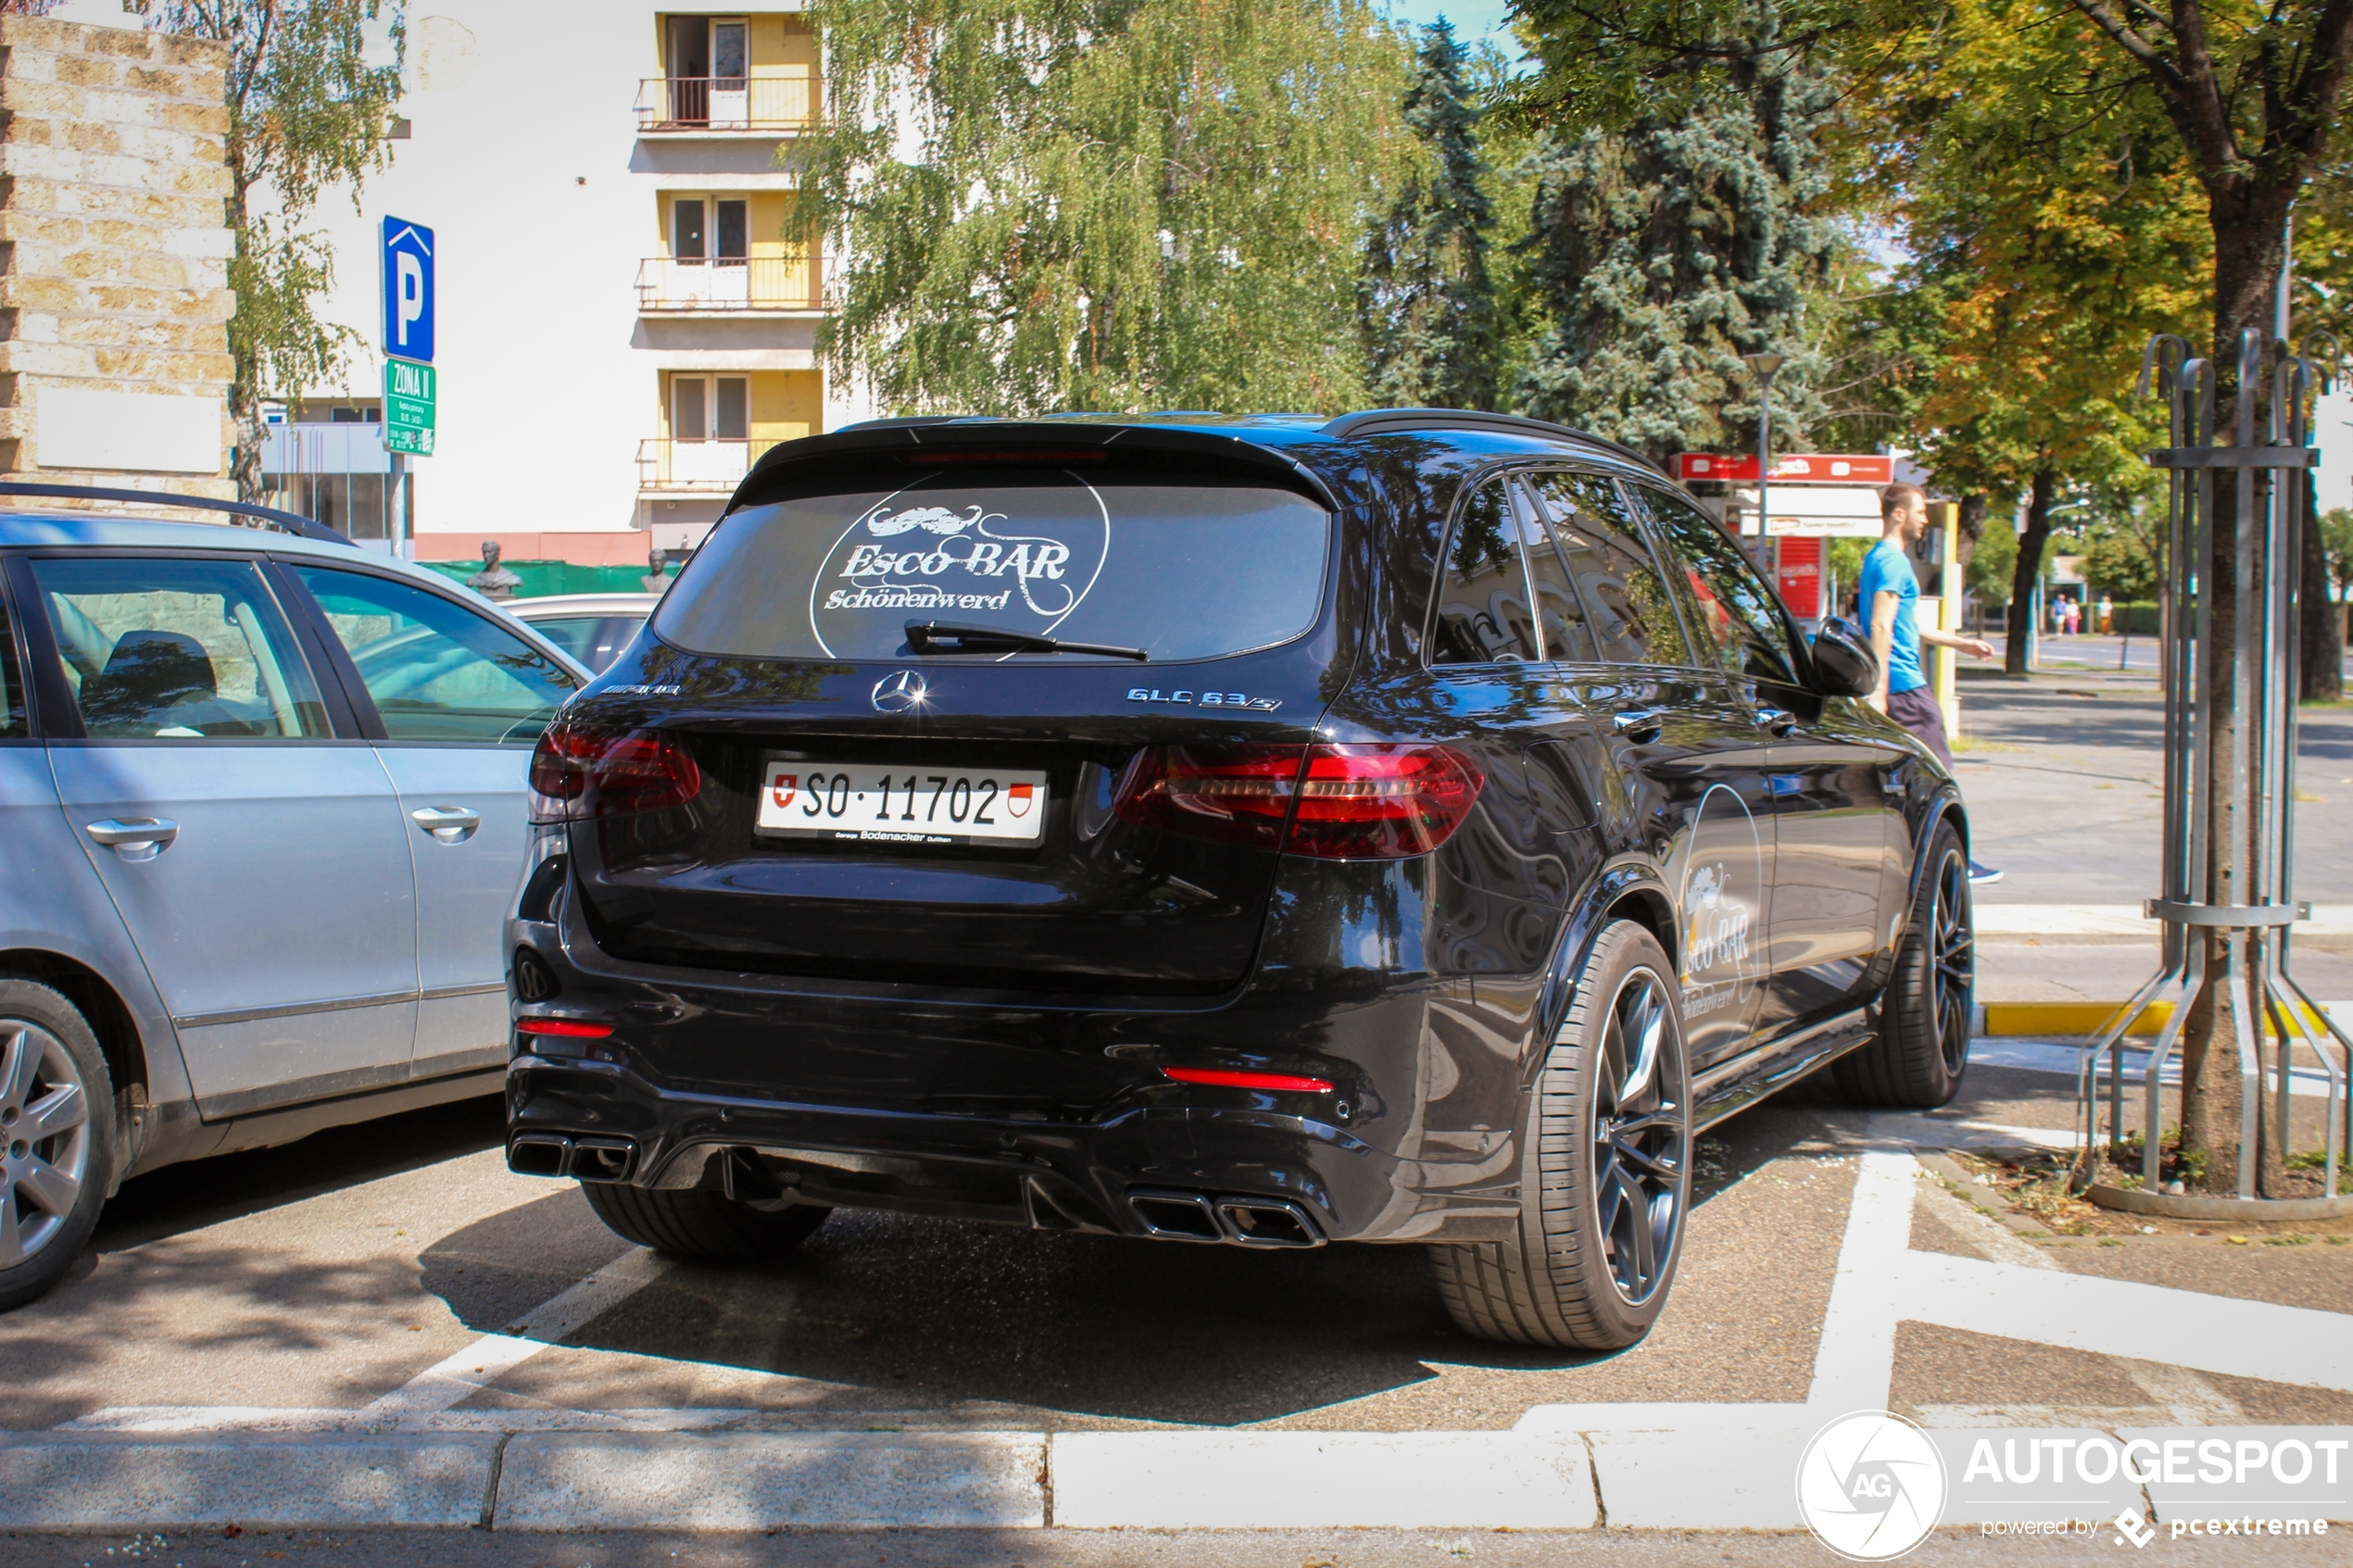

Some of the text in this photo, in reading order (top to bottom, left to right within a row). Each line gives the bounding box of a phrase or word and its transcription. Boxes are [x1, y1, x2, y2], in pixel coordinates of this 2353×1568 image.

[396, 250, 423, 346] P
[394, 363, 430, 399] ZONA II
[968, 543, 1070, 580] BAR
[824, 589, 1013, 611] Schönenwerd
[1126, 688, 1193, 705] GLC
[835, 831, 859, 840] Garage
[860, 831, 925, 843] Bodenacker
